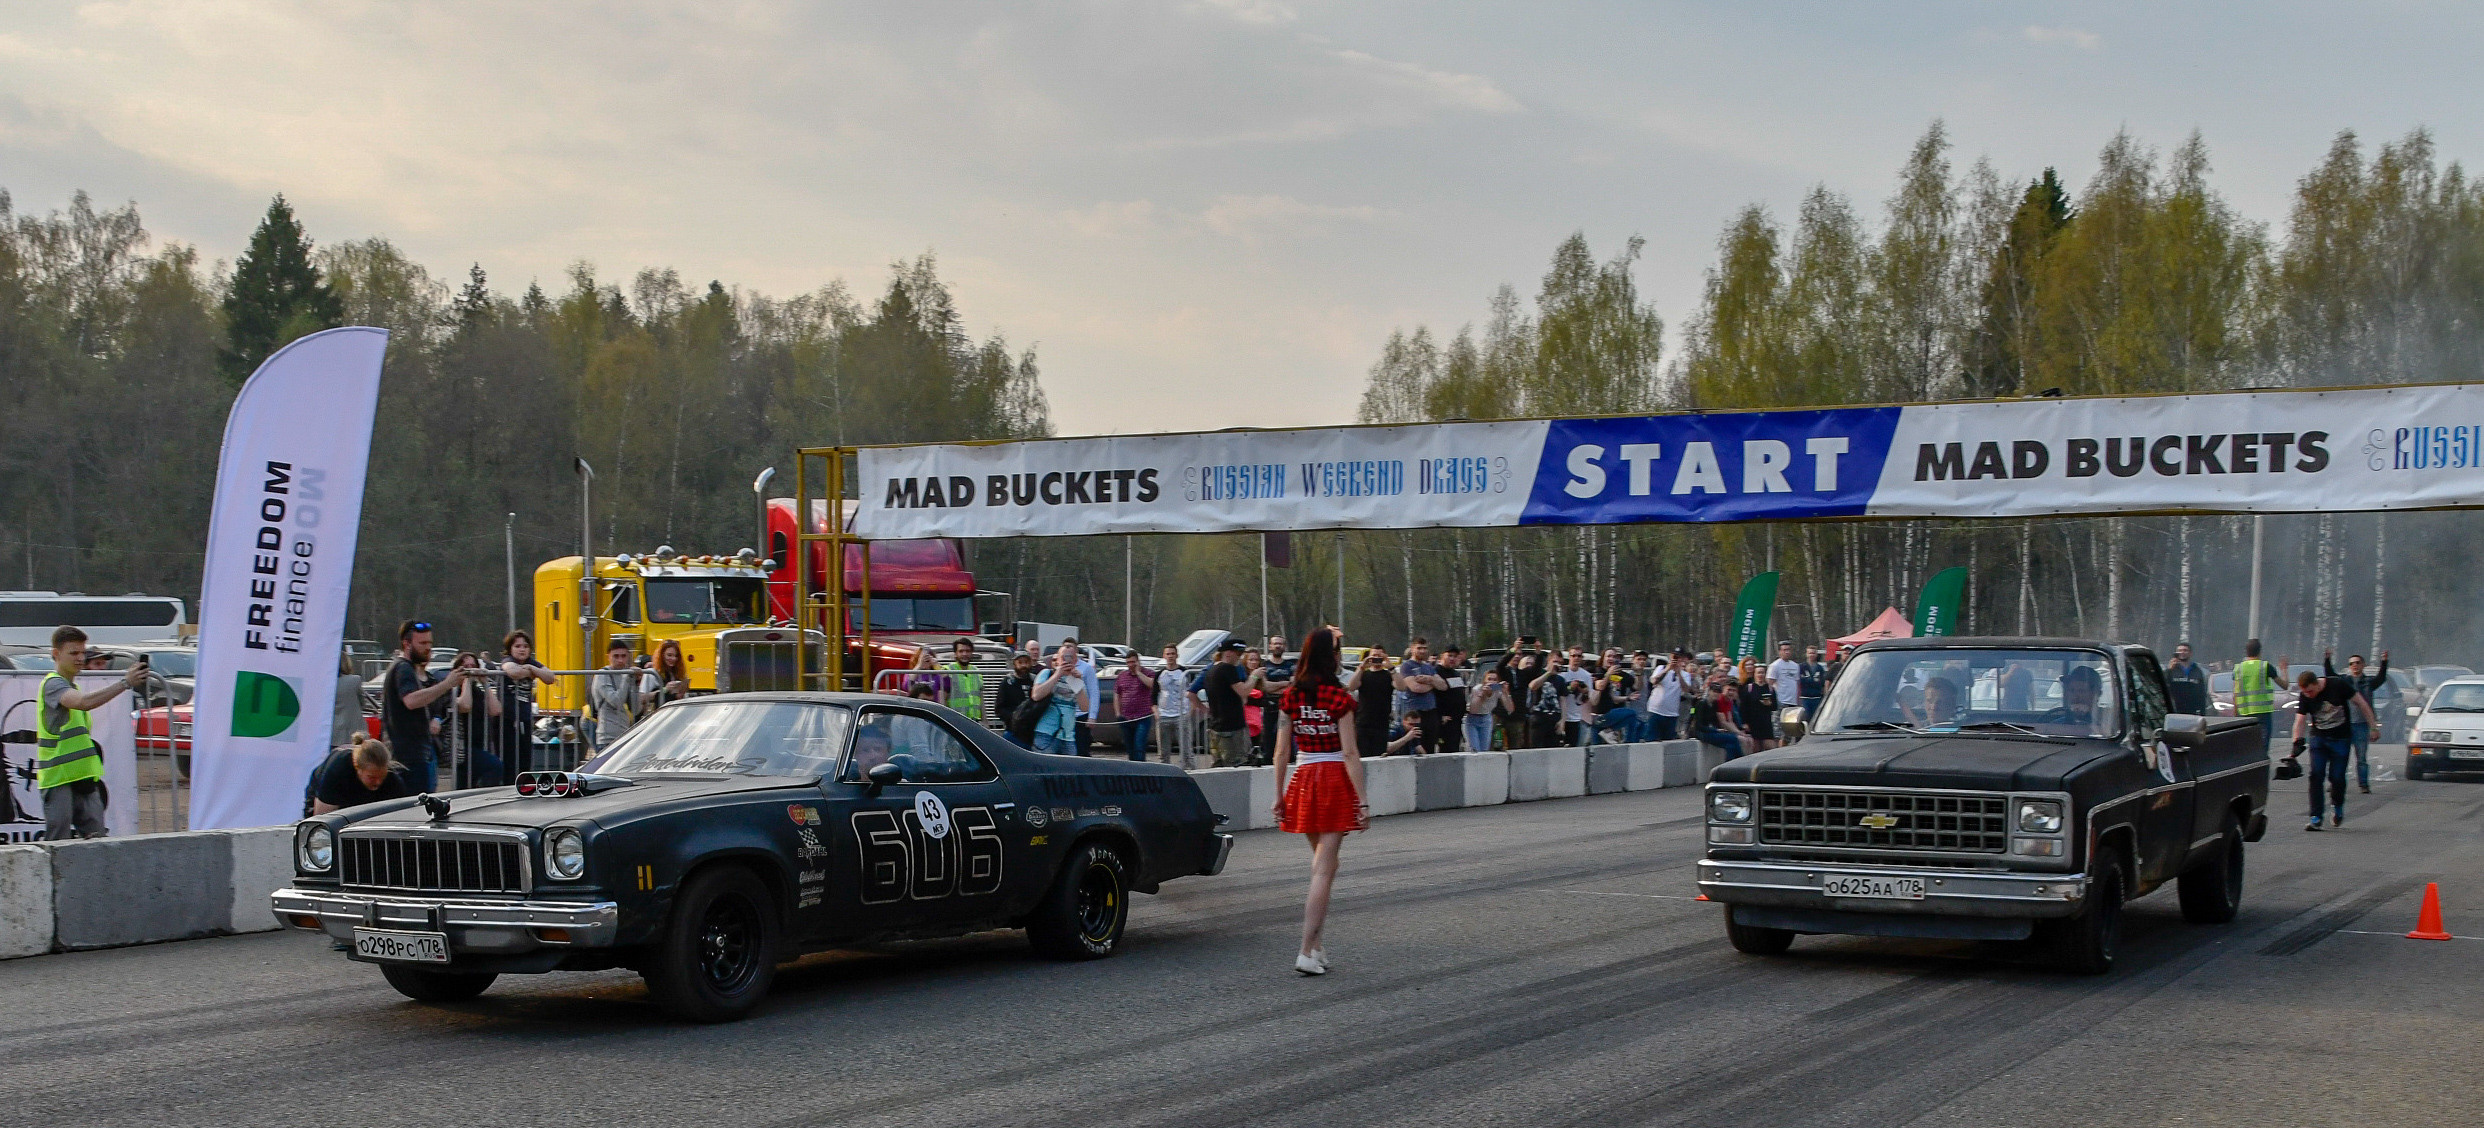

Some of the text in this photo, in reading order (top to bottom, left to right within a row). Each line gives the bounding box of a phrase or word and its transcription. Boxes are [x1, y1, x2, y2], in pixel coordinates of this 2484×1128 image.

[1563, 437, 1849, 499] START
[1914, 431, 2330, 482] MAD BUCKETS
[885, 468, 1160, 509] MAD BUCKETS
[1202, 457, 1488, 500] RUSSIAN WEEKEND DRAGS
[244, 461, 292, 651] FREEDOM
[274, 541, 314, 654] finance
[1299, 705, 1331, 722] Hey,
[921, 799, 941, 822] 43
[851, 806, 1003, 905] 606
[1896, 880, 1920, 893] 178
[417, 938, 442, 953] 178
